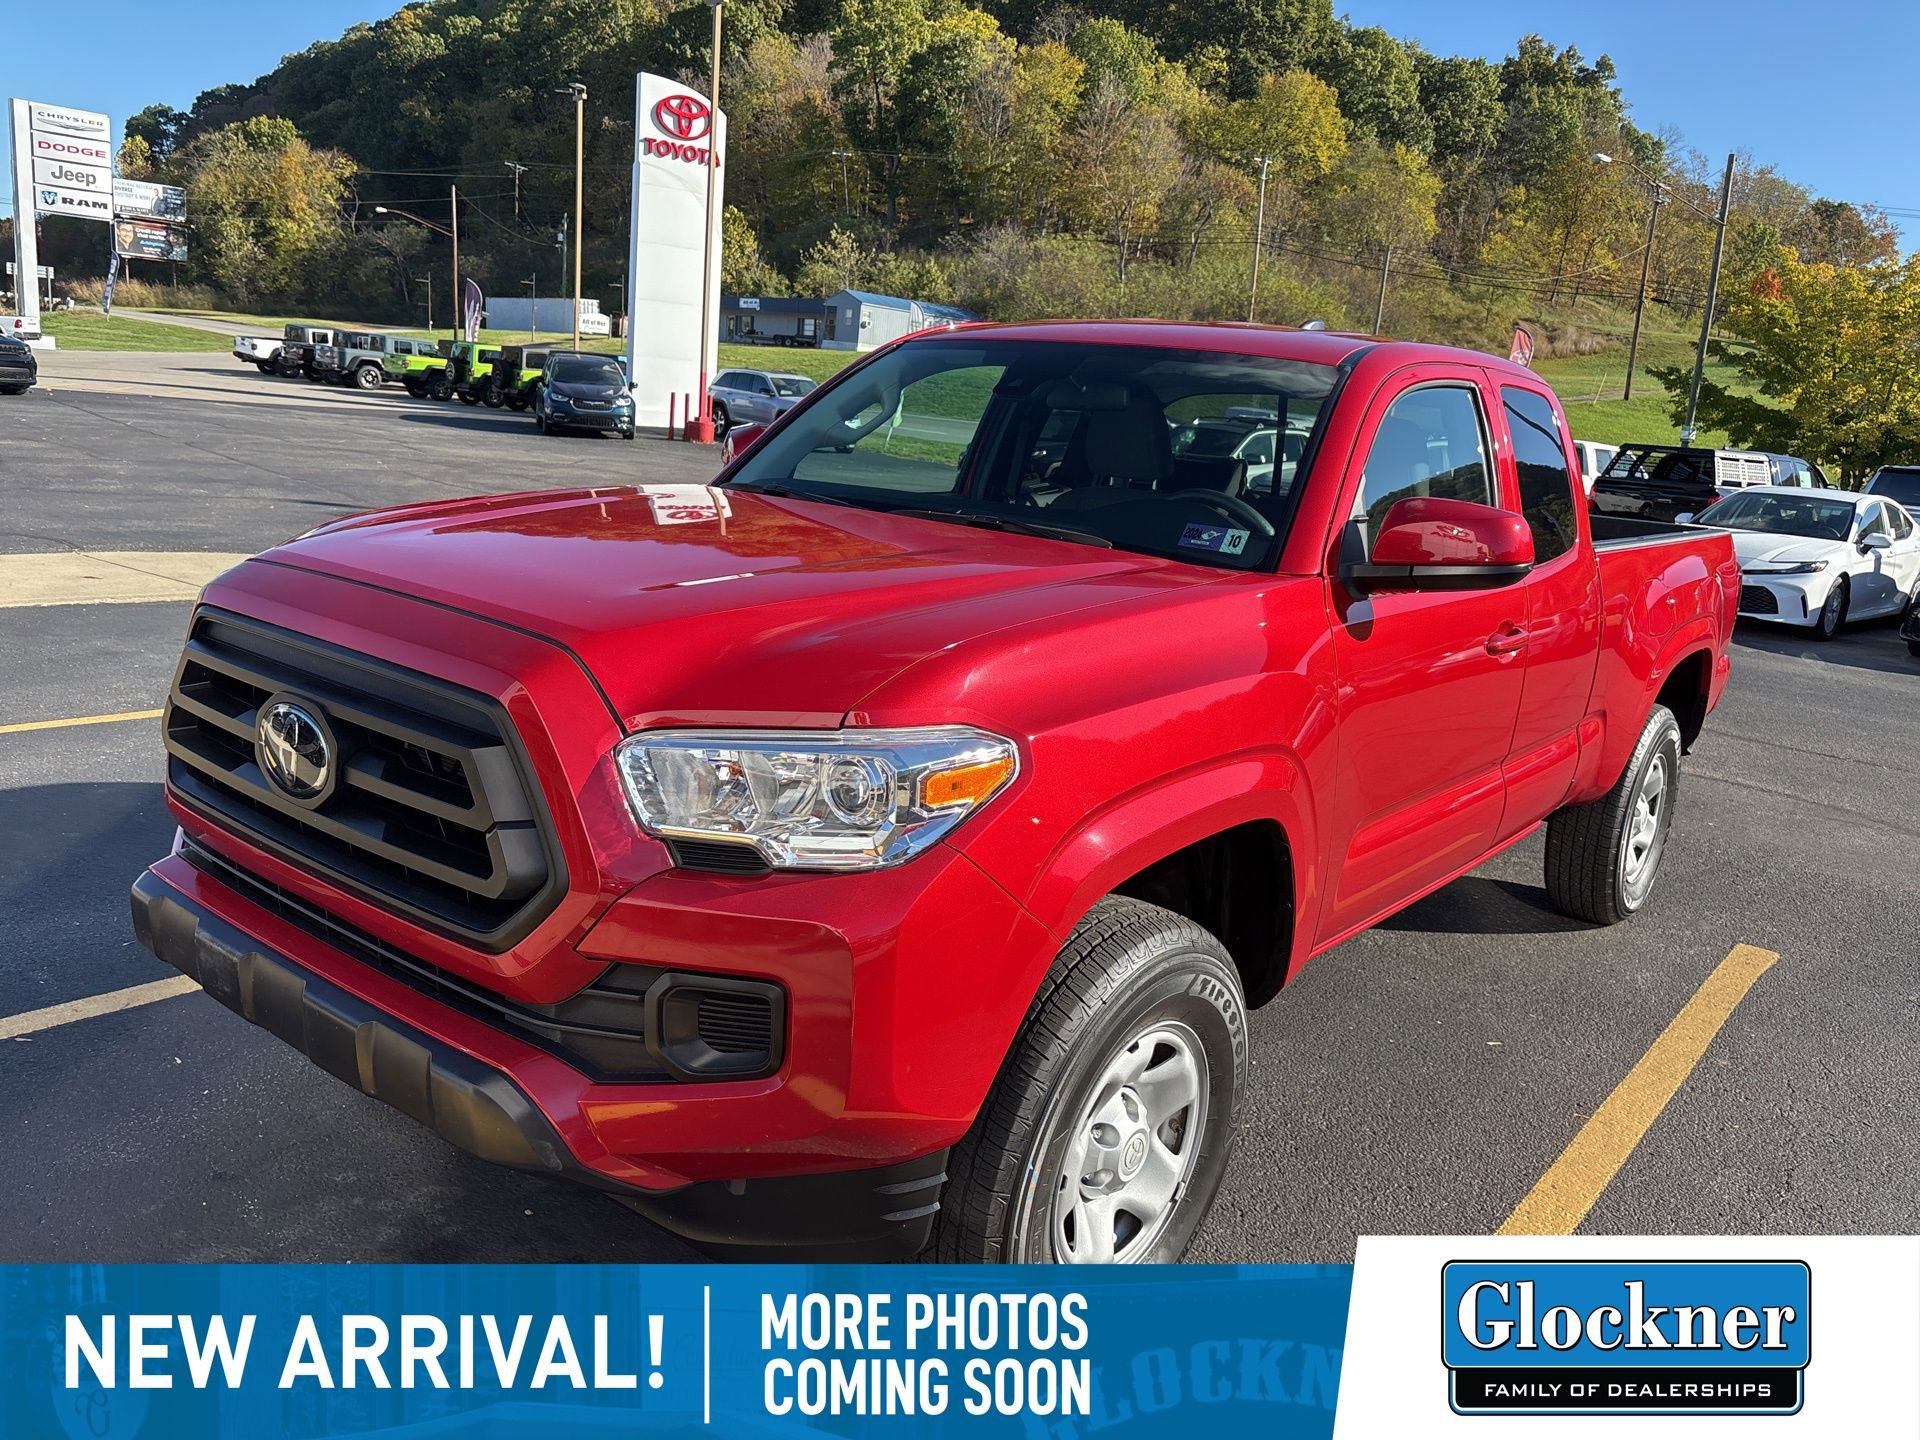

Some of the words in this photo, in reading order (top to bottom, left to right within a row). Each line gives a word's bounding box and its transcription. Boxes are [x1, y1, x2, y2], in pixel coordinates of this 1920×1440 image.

[37, 111, 104, 127] CHRYSLER
[37, 140, 107, 159] DODGE
[50, 164, 97, 187] Jeep
[61, 196, 108, 210] RAM
[1227, 534, 1242, 549] 10
[1198, 976, 1246, 1102] Firestone
